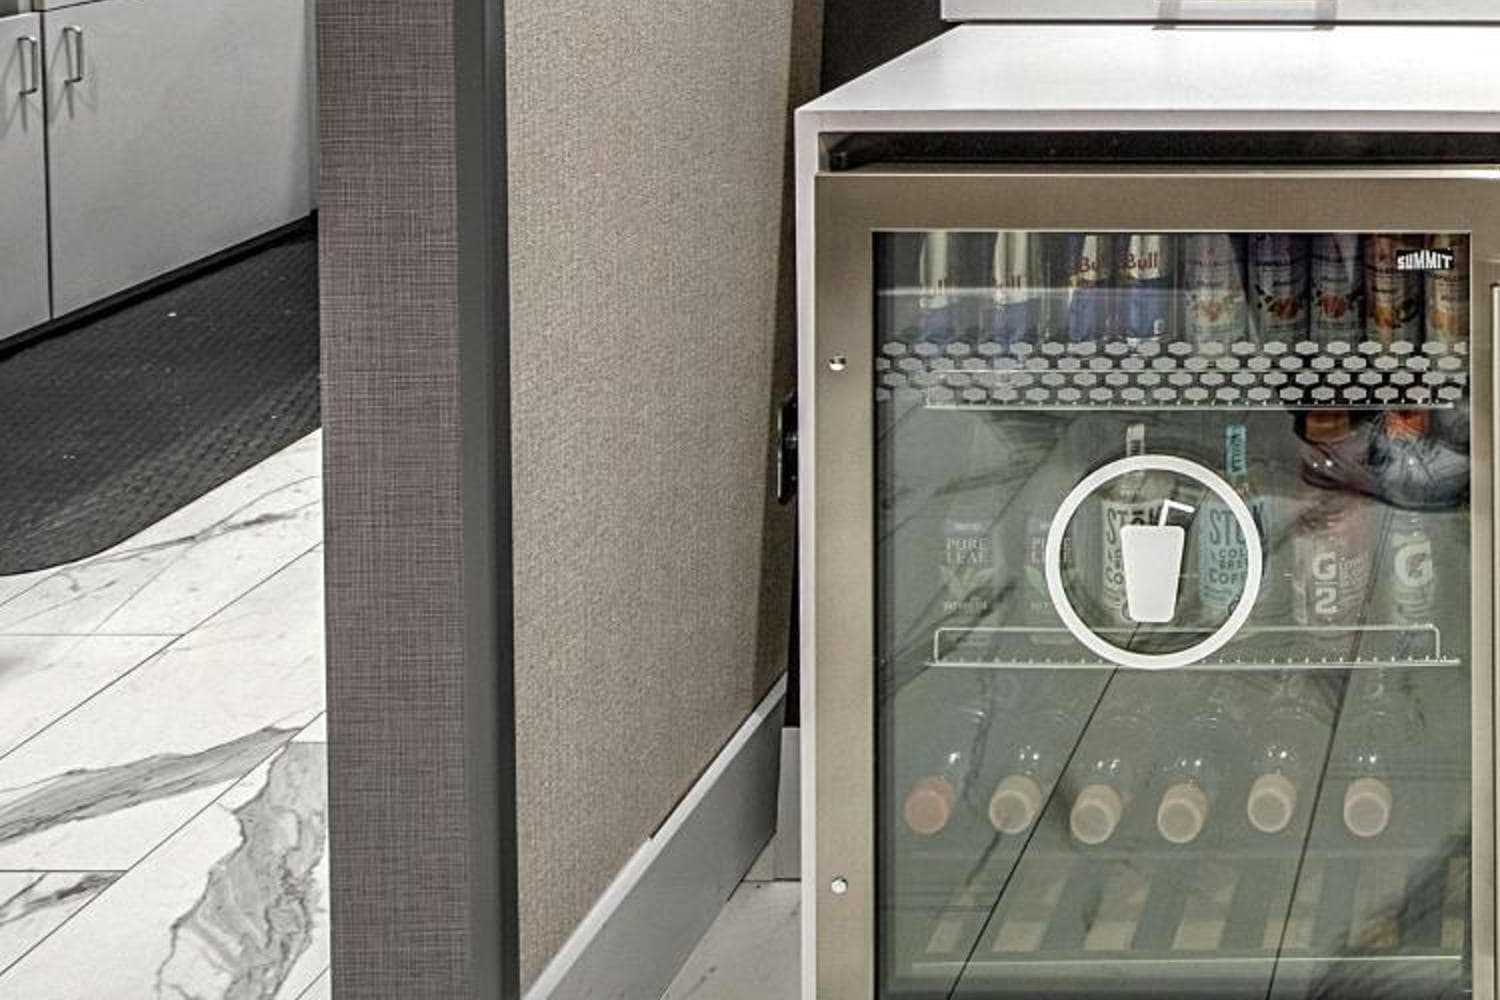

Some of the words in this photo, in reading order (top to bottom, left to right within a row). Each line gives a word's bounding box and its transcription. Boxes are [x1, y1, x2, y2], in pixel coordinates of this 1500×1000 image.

[1396, 249, 1453, 271] SUMMIT
[1311, 551, 1338, 581] G
[1314, 587, 1339, 615] 2
